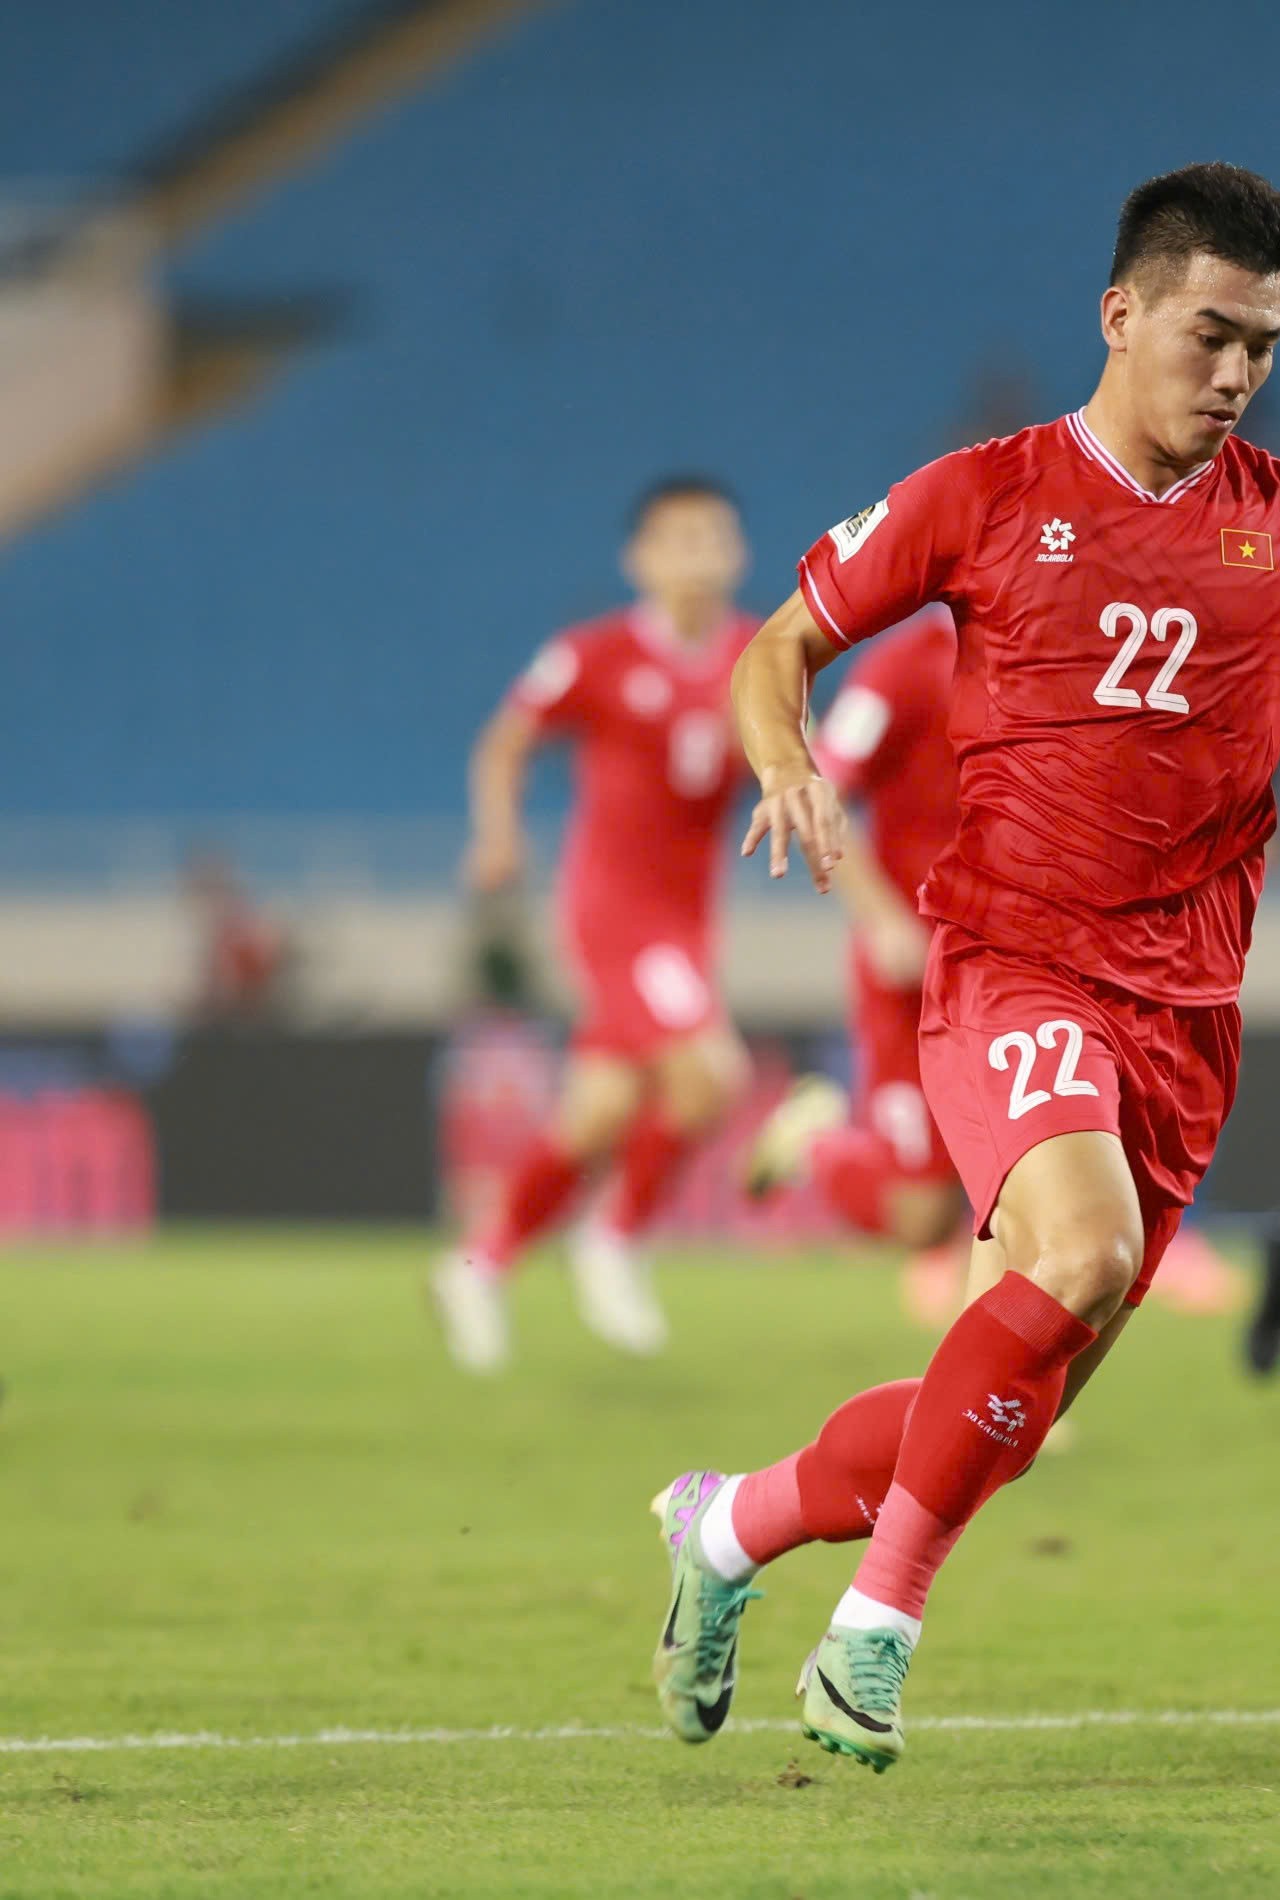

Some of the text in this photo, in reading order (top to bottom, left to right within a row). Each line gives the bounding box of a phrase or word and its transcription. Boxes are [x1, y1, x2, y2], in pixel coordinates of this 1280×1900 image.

[1035, 553, 1074, 563] JOGARBOLA
[1093, 601, 1198, 714] 22
[988, 1019, 1100, 1120] 22
